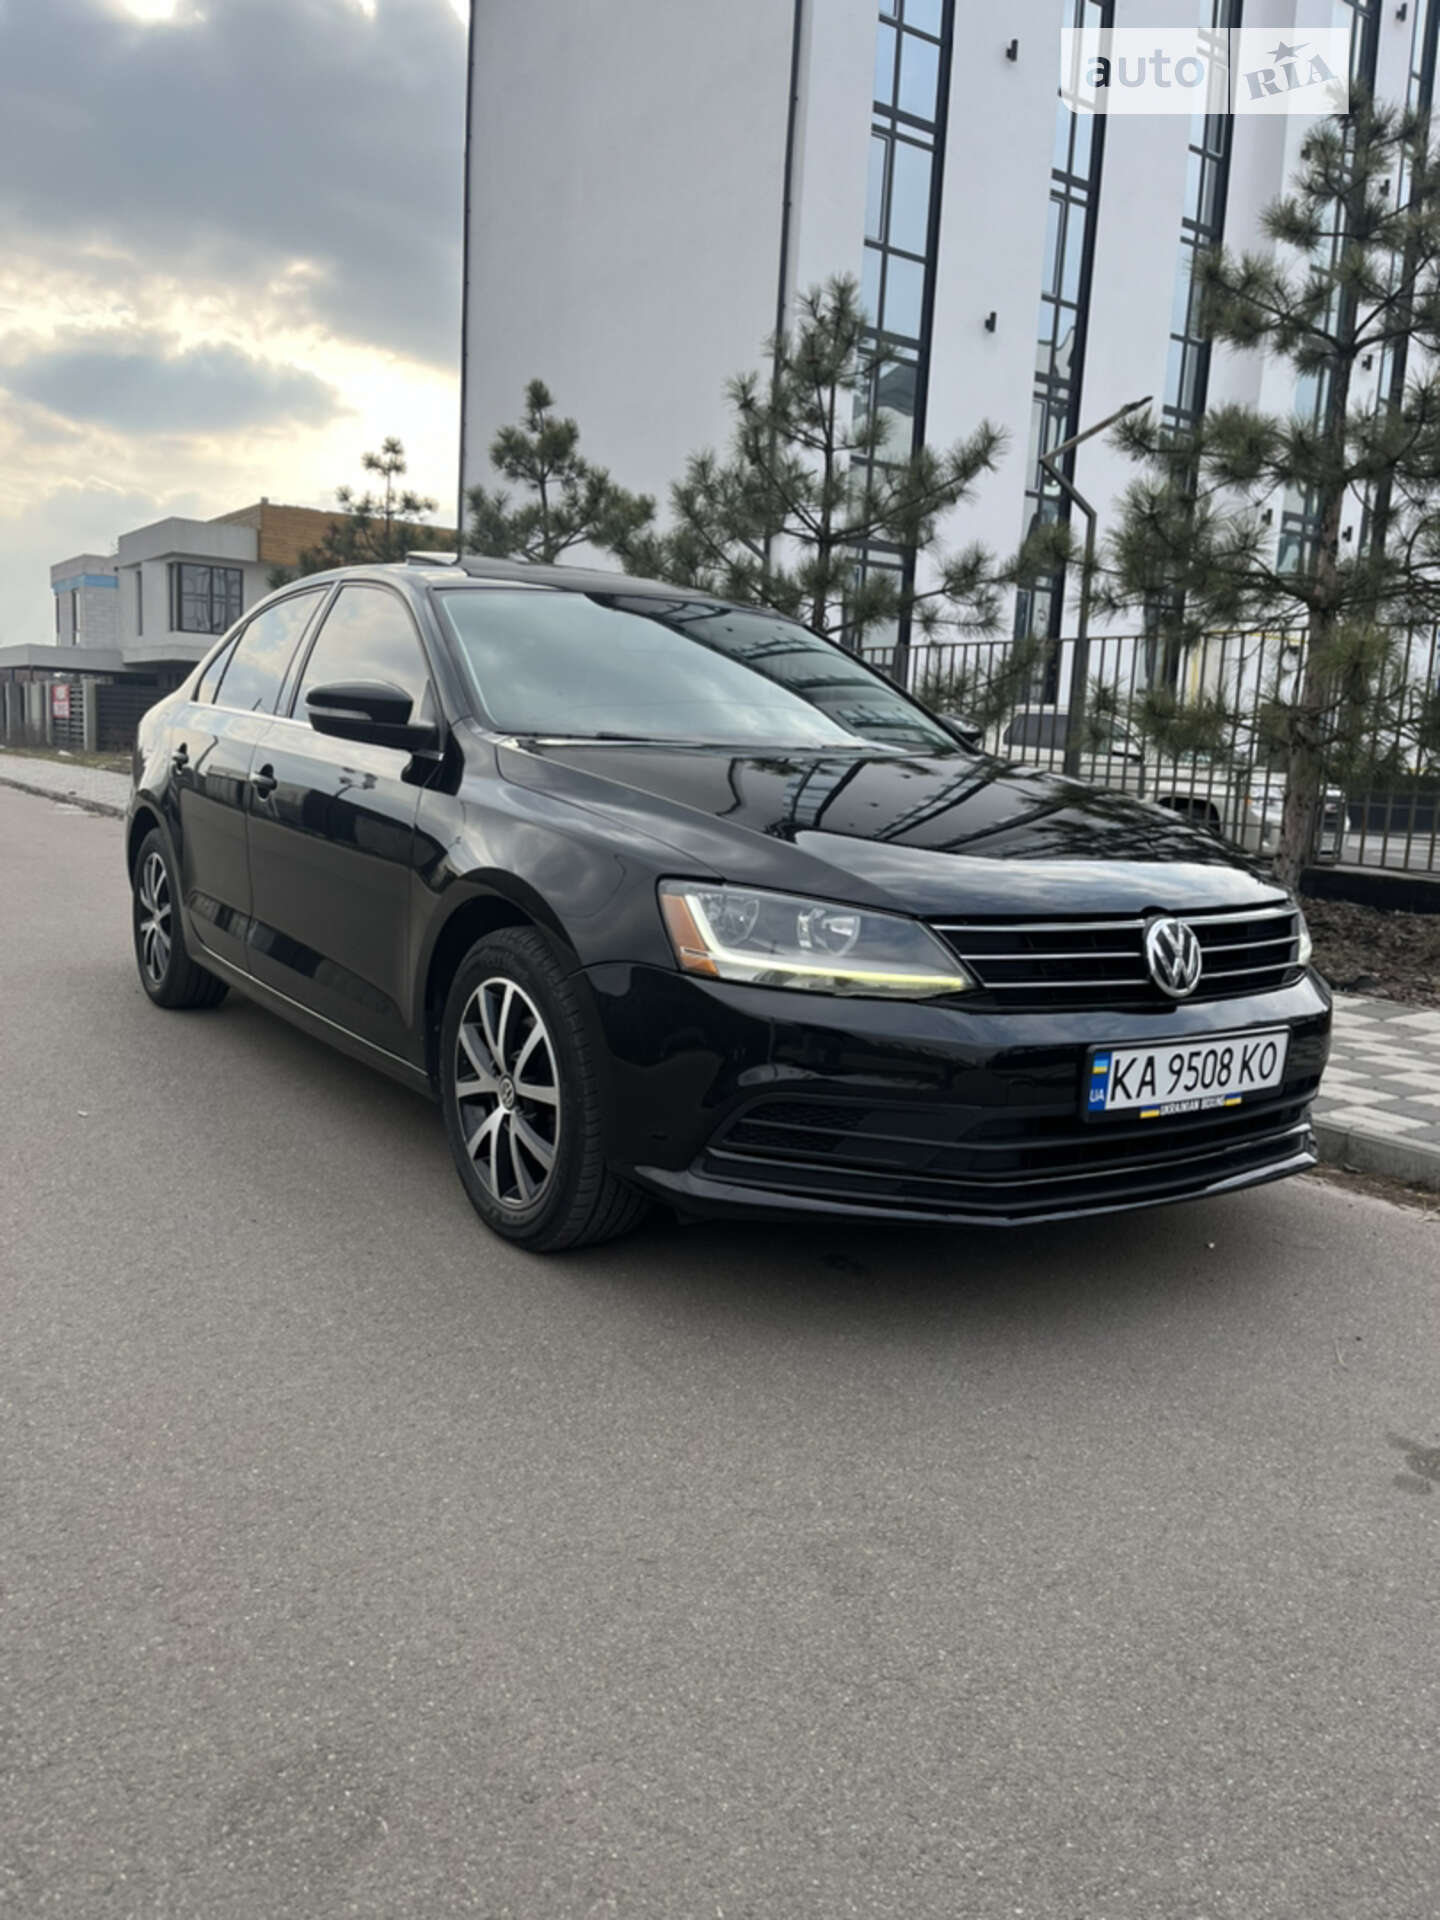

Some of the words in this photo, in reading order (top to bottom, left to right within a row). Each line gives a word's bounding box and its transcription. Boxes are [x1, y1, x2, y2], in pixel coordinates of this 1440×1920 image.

[1110, 1055, 1156, 1102] KA
[1167, 1046, 1234, 1095] 9508
[1238, 1041, 1277, 1084] KO
[1089, 1088, 1104, 1103] UA
